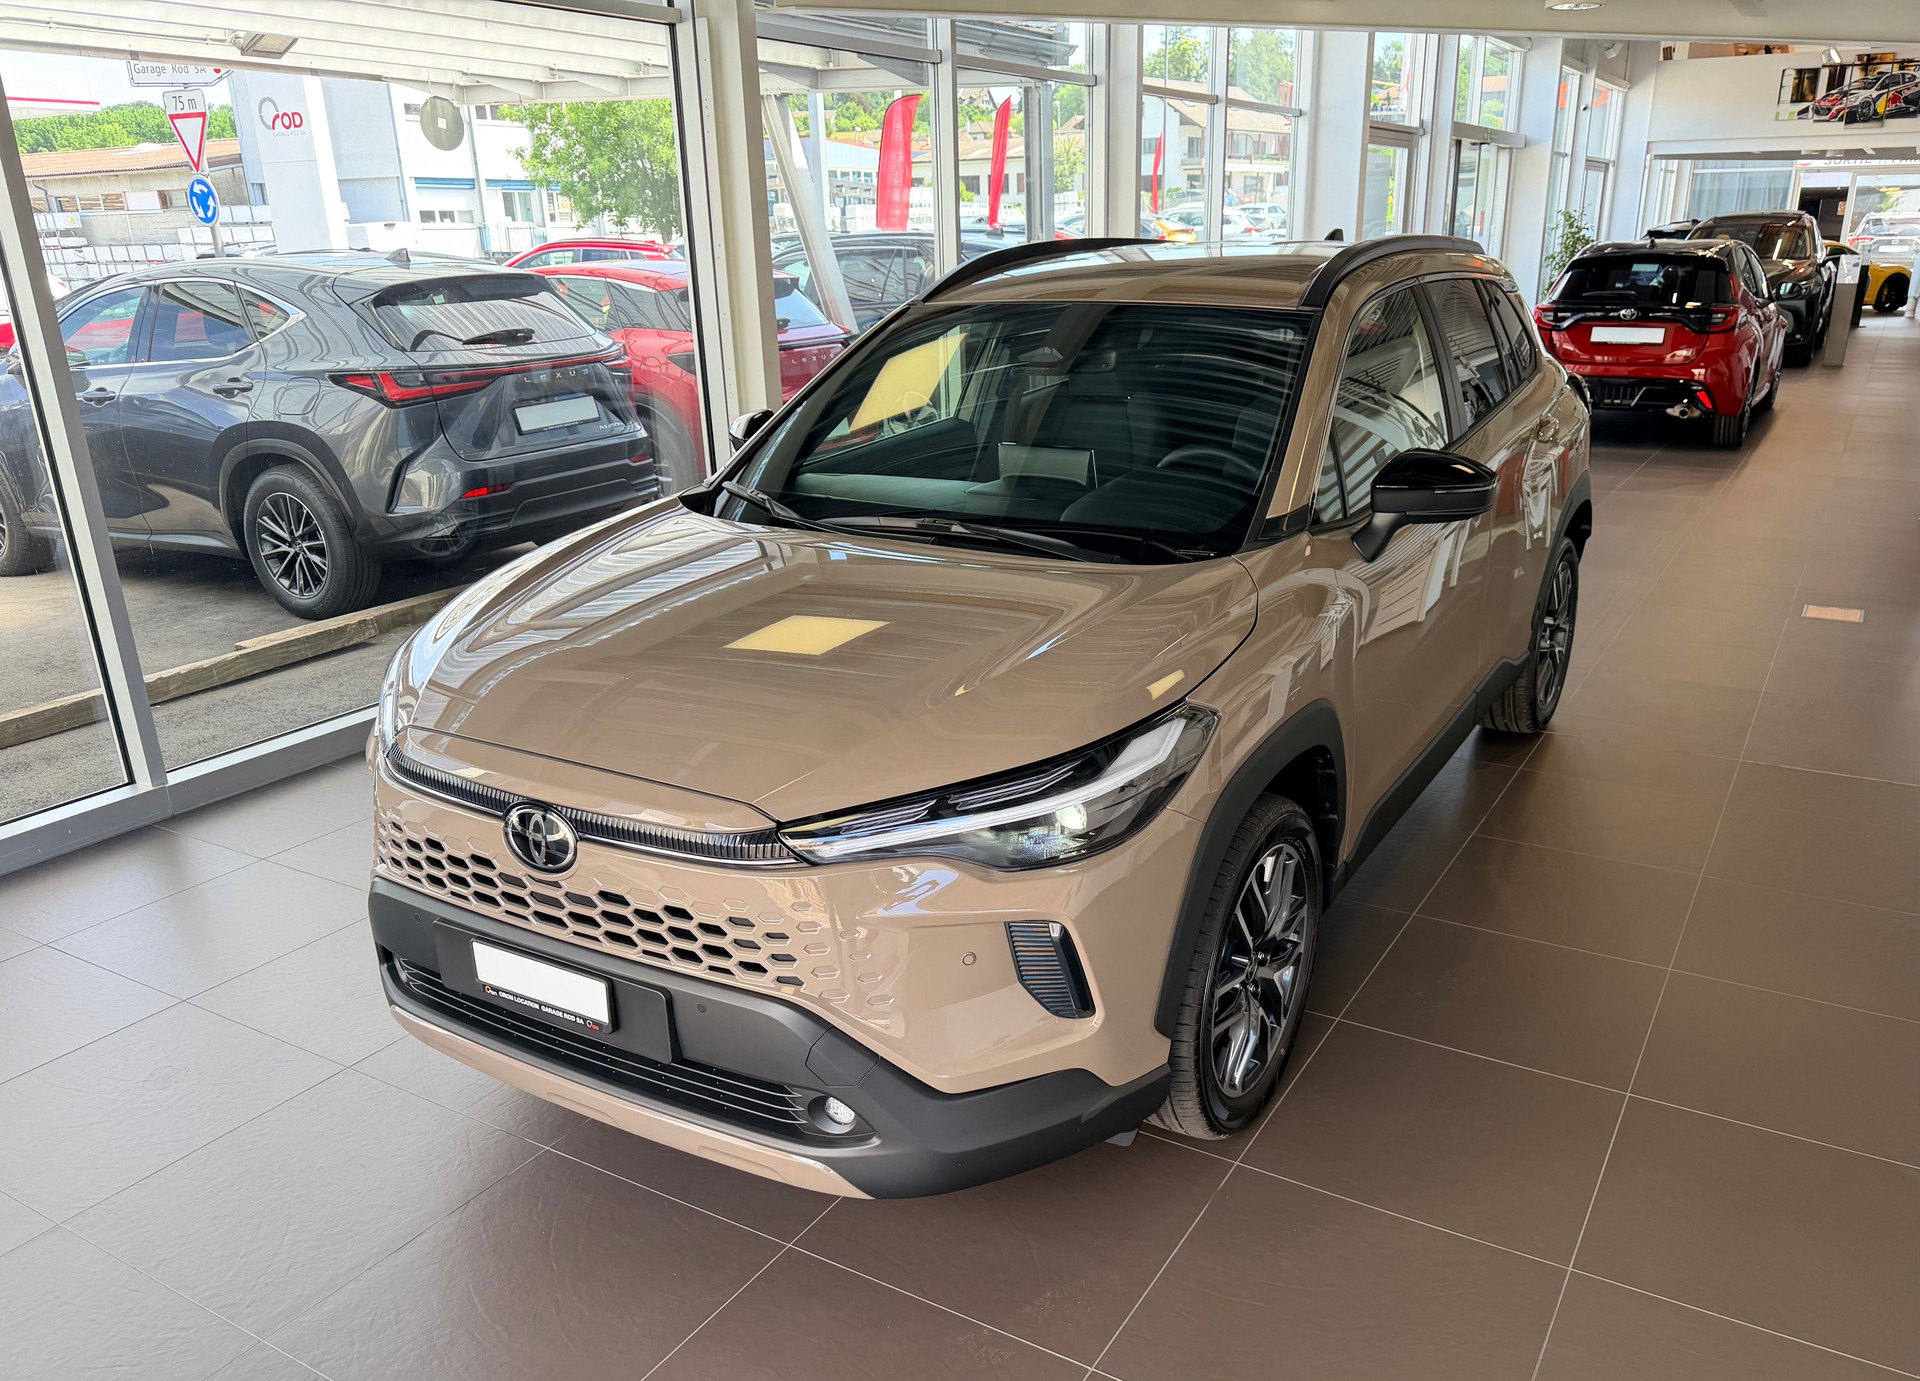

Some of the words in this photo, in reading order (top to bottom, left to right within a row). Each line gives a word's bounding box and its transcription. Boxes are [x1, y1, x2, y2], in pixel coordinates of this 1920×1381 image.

[133, 63, 166, 76] Garage
[172, 95, 185, 111] 75
[187, 97, 198, 110] m
[523, 368, 590, 383] LEXUS
[498, 991, 513, 1001] ORON
[514, 996, 540, 1010] LOCATION
[541, 1005, 564, 1018] GARAGE
[563, 1012, 576, 1021] ROD
[576, 1017, 585, 1025] SA
